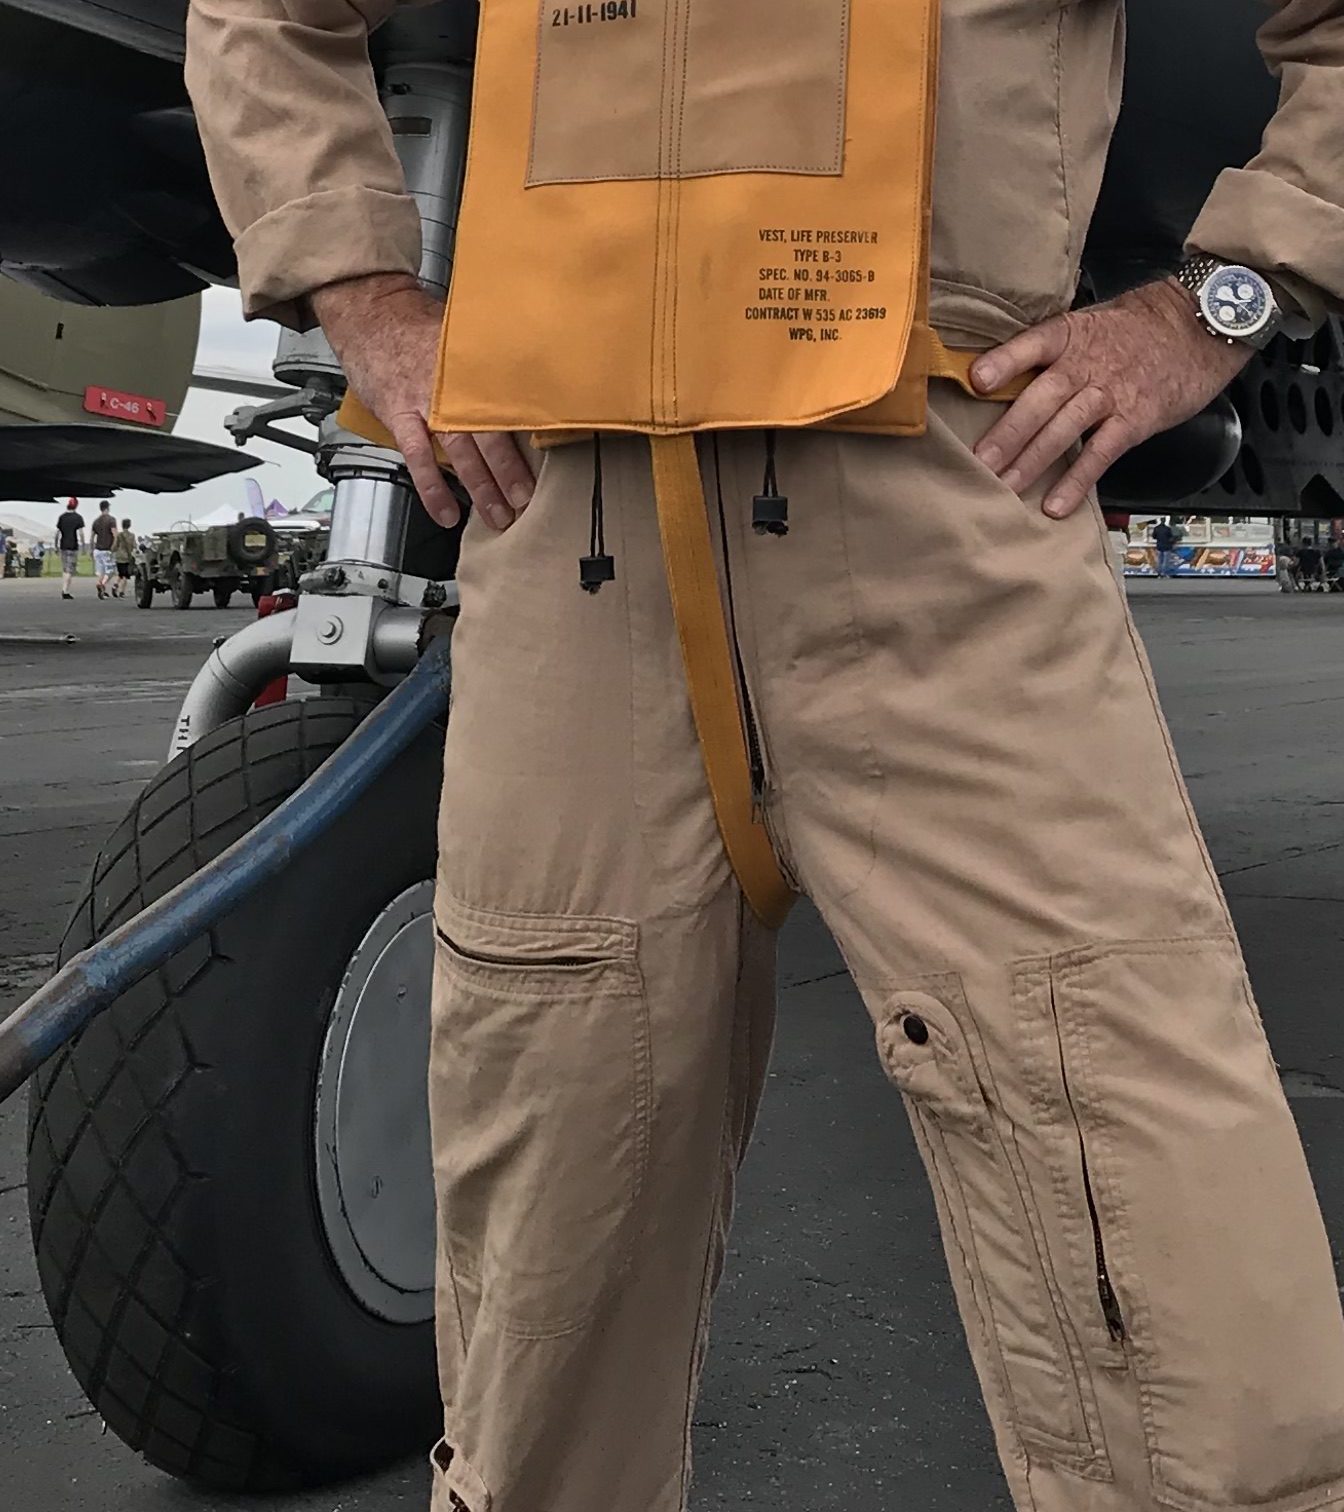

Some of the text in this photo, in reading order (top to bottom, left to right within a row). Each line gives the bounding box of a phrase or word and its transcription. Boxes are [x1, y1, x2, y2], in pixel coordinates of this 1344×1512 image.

[759, 229, 878, 244] VEST, LIFE PRESERVER
[793, 249, 842, 263] TYPE B-3
[759, 268, 789, 281] SPEC.
[793, 269, 813, 281] NO.
[759, 287, 830, 302] DATE OF MFR.
[745, 307, 799, 320] CONTRACT
[802, 308, 813, 321] W
[816, 309, 836, 322] 535
[838, 309, 853, 321] AC
[789, 327, 842, 342] WPG, INC.
[109, 397, 140, 414] C-46
